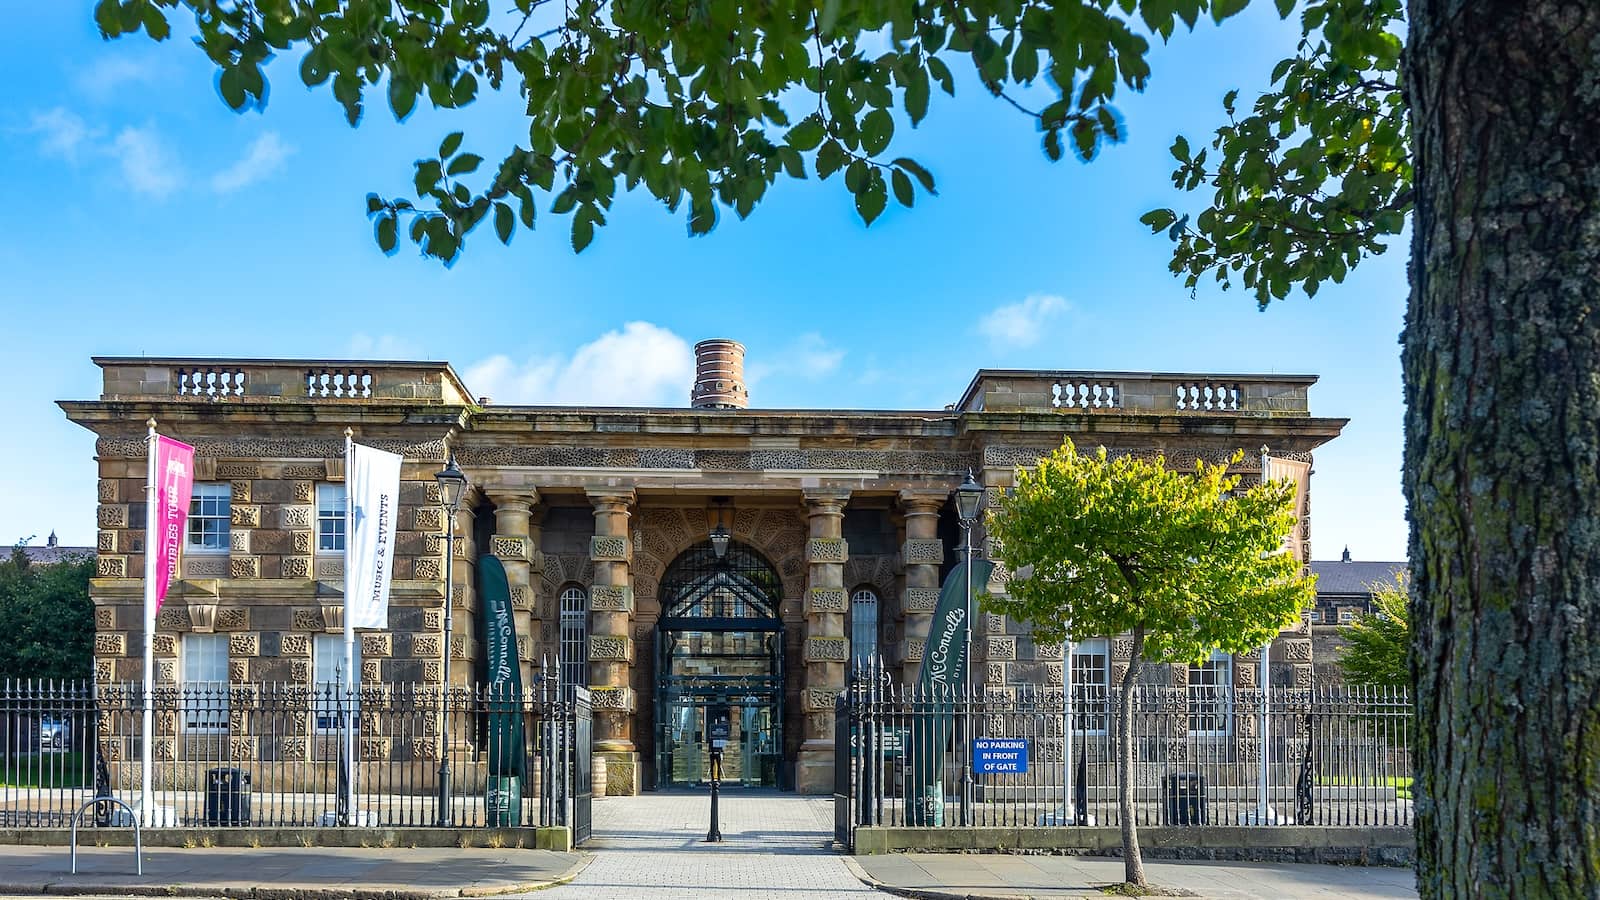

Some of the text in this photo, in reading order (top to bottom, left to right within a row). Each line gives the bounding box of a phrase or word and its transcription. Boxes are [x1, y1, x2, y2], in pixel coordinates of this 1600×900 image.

[167, 485, 179, 518] TOUR
[373, 494, 388, 601] MUSIC & EVENTS
[931, 608, 965, 697] McConnell's
[976, 741, 1025, 749] NO PARKING
[982, 752, 1018, 760] IN FRONT
[983, 763, 1018, 771] OF GATE
